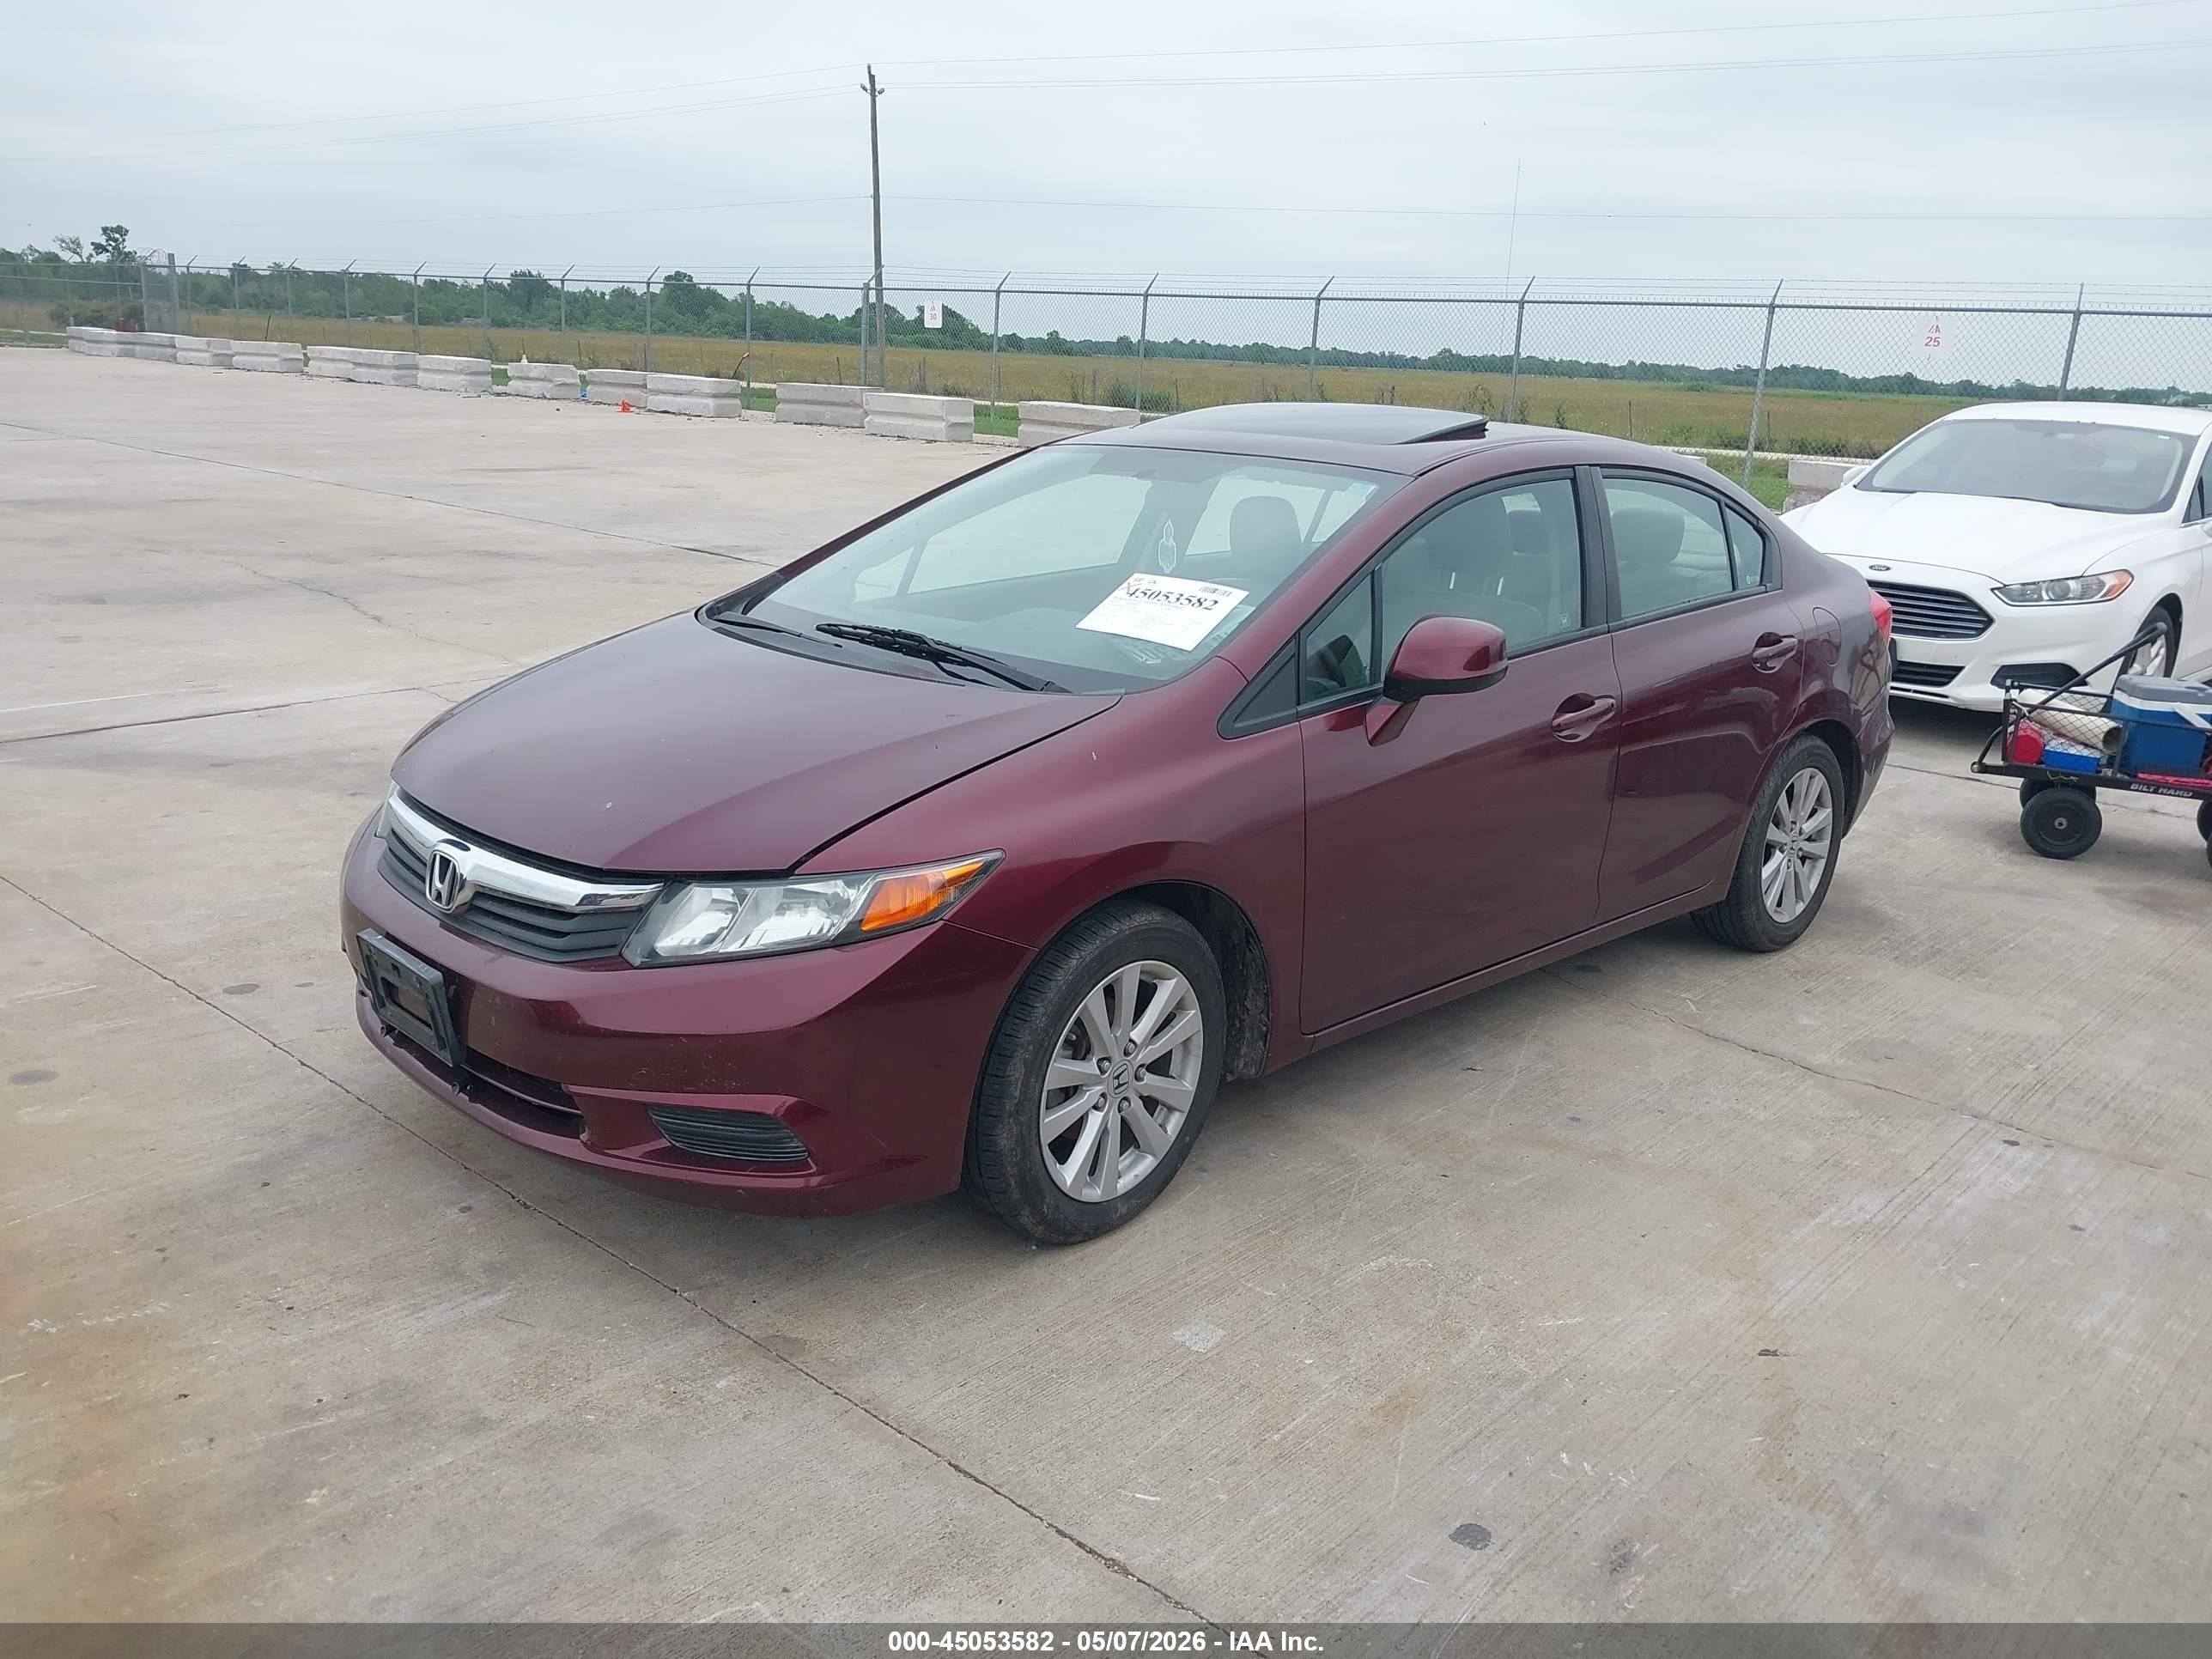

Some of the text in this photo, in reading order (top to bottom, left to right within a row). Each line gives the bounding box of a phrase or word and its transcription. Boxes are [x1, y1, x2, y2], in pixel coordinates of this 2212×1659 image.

[1924, 336, 1941, 347] 25
[1126, 587, 1219, 611] 45053582
[2130, 782, 2193, 797] BILT HARD
